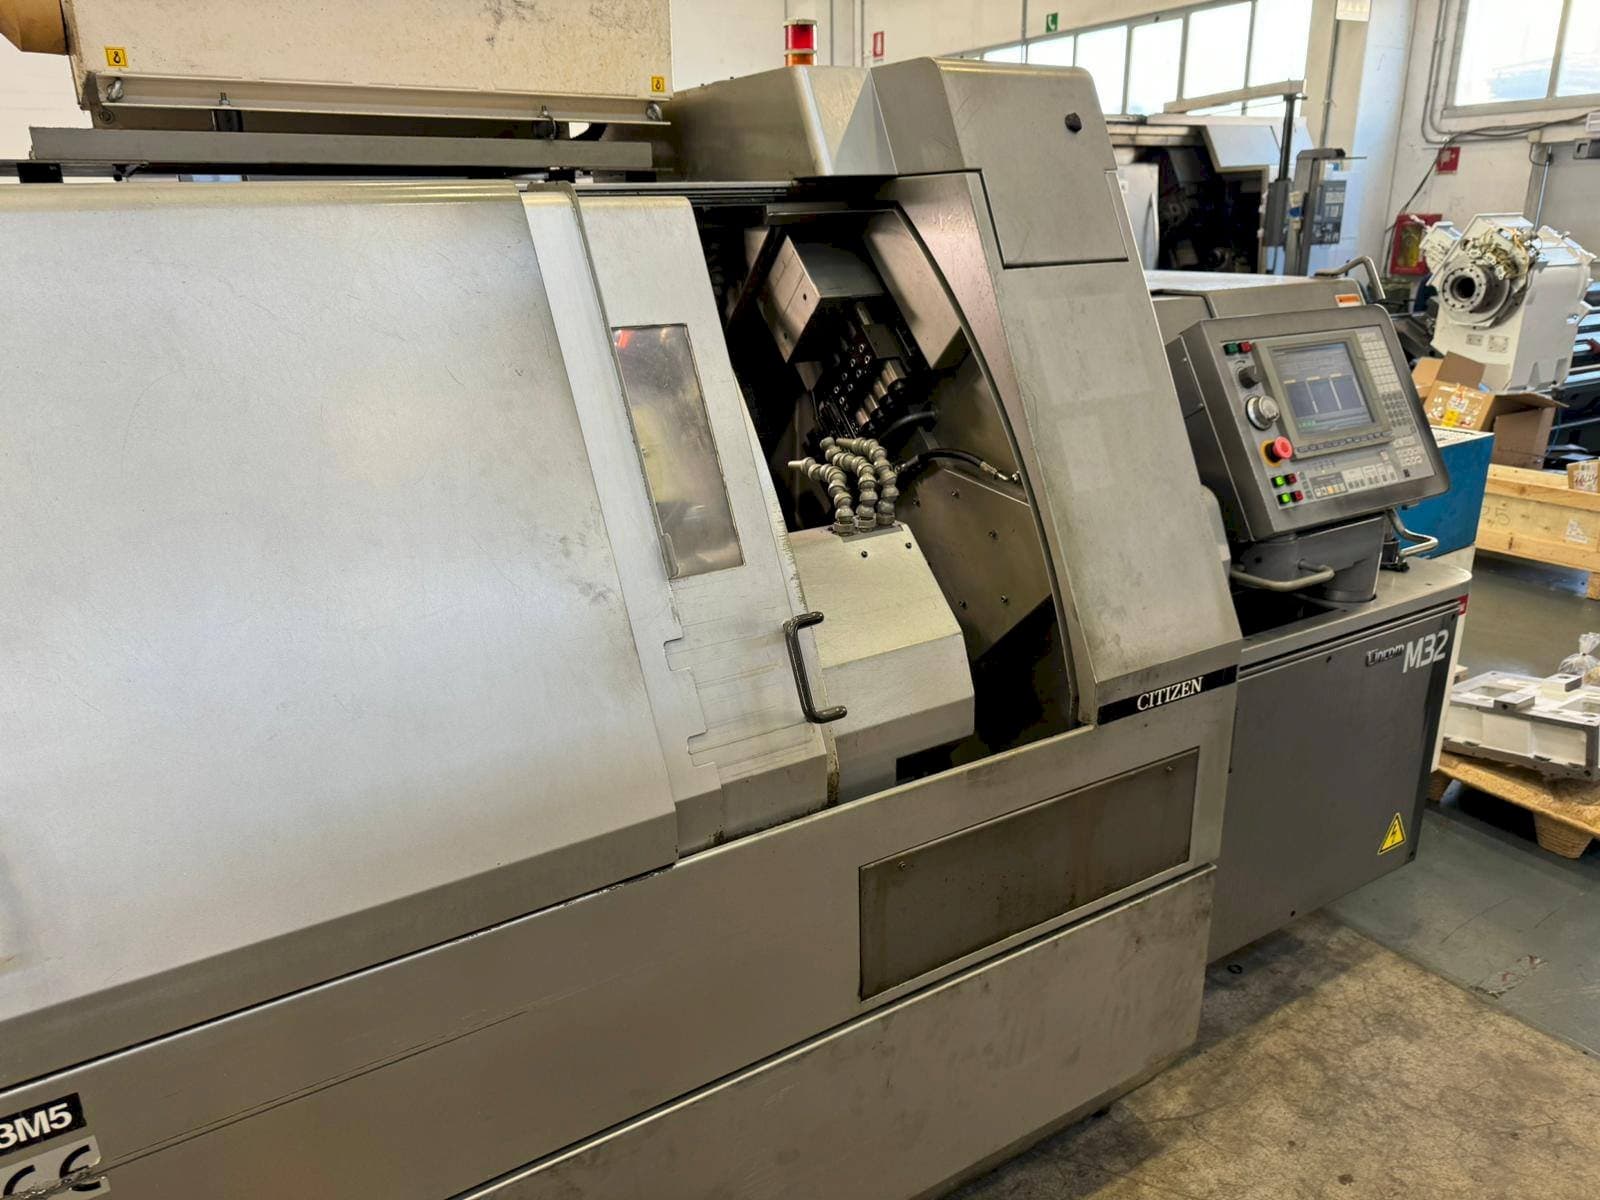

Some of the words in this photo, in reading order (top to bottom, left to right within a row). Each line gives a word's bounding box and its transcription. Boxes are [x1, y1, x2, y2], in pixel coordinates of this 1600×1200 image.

[1402, 629, 1449, 674] M32
[1136, 676, 1204, 711] CITIZEN
[0, 1102, 73, 1149] 3M5
